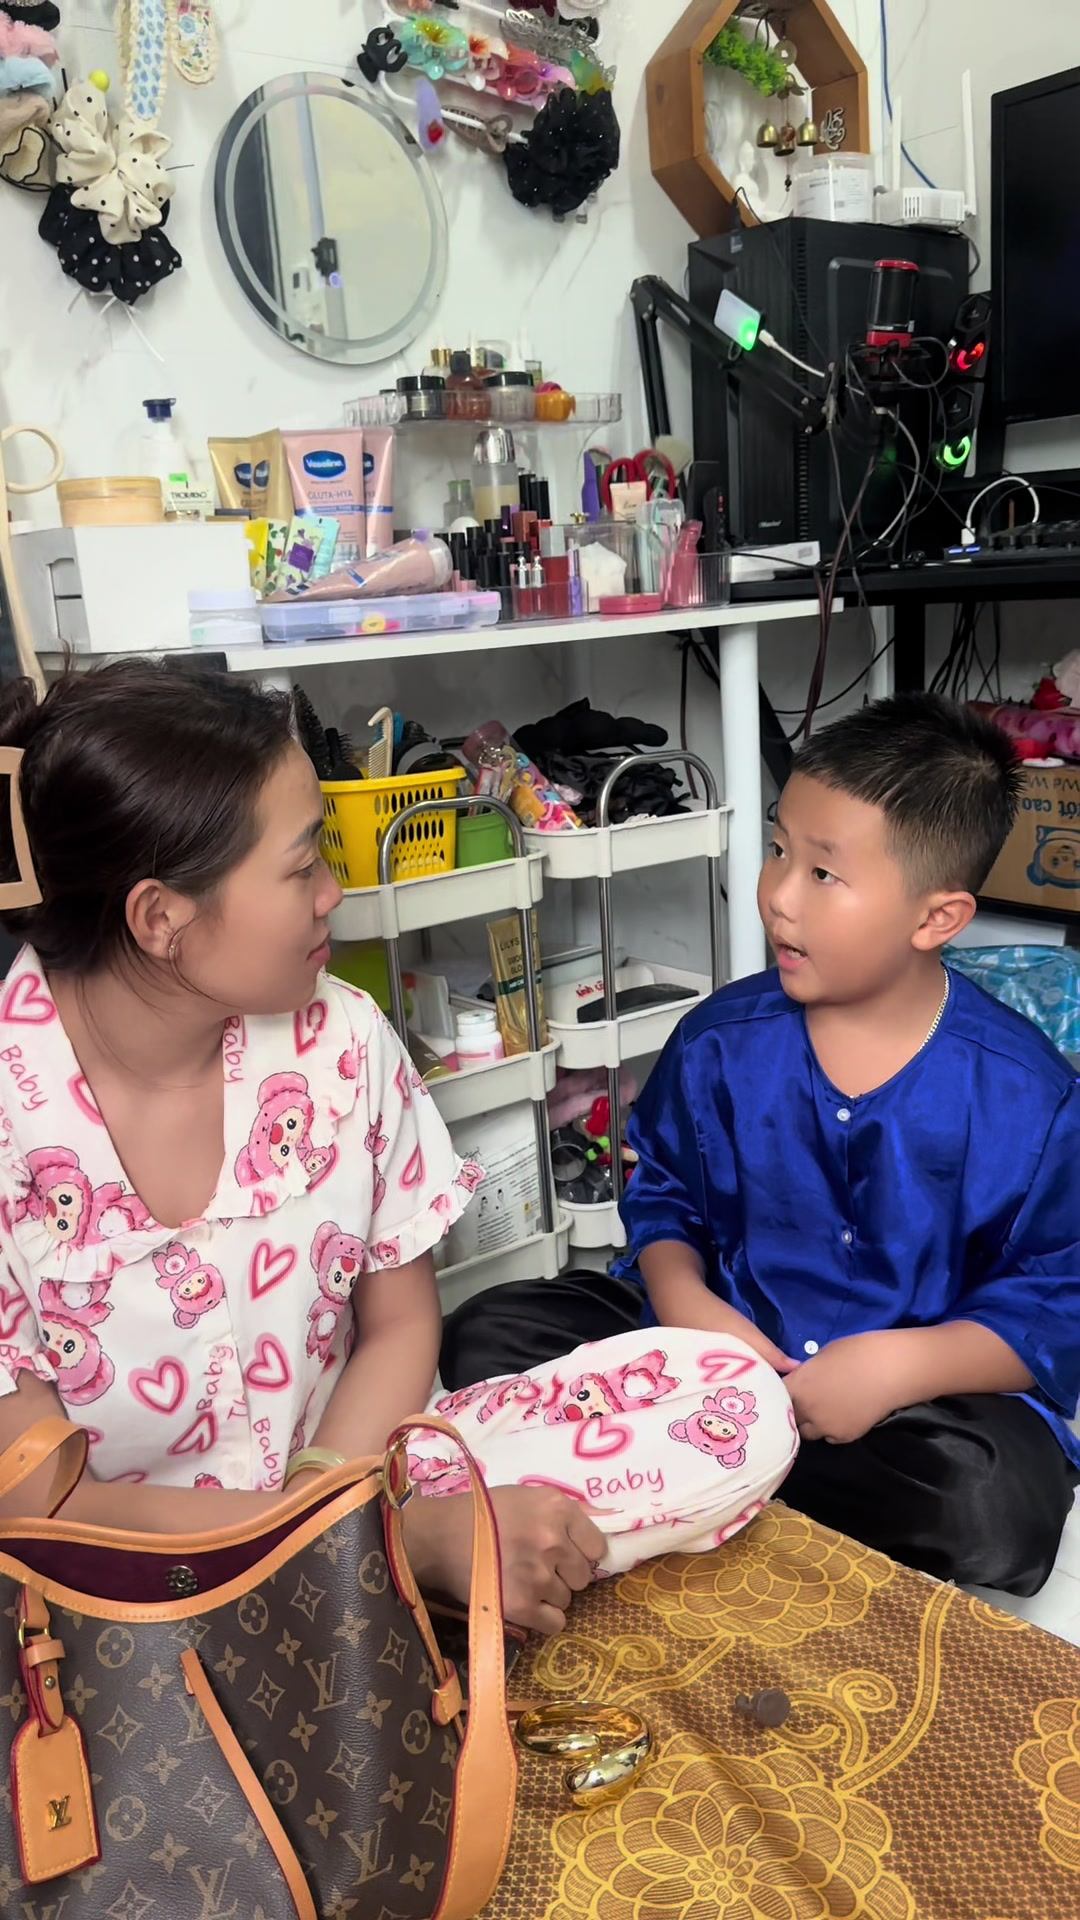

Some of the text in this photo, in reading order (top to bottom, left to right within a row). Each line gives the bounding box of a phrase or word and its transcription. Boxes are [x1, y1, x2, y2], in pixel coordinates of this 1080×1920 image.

[0, 1044, 49, 1111] Baby
[223, 1015, 244, 1083] Baby
[253, 1416, 283, 1488] Baby
[585, 1468, 664, 1498] Baby
